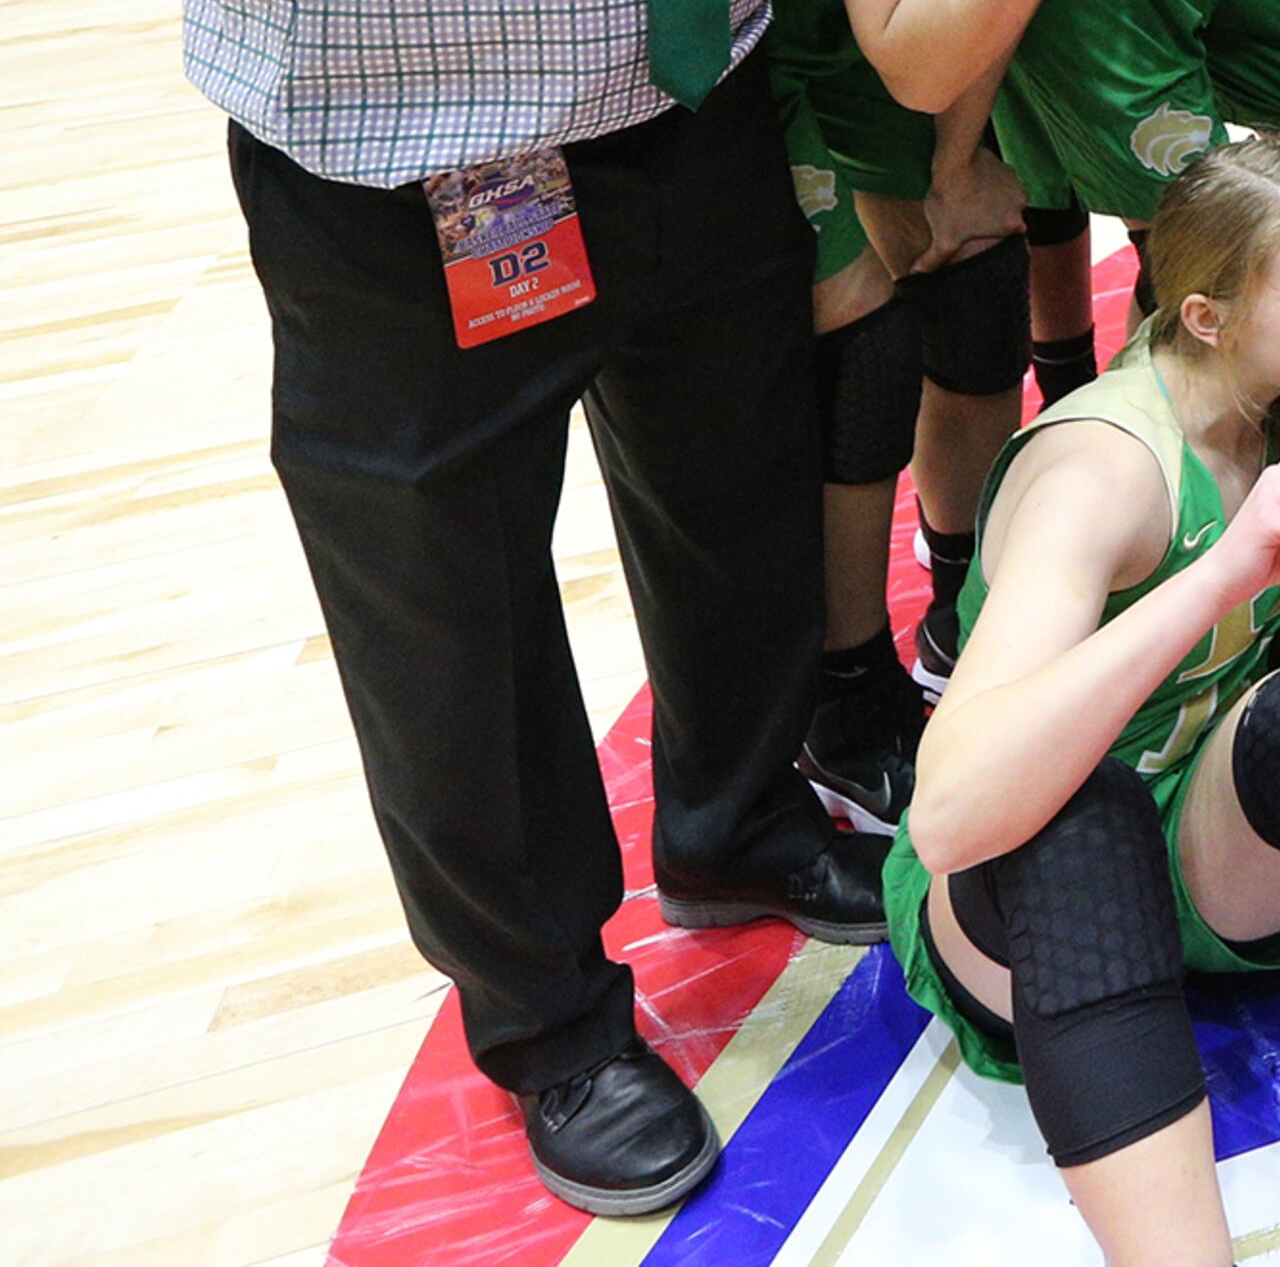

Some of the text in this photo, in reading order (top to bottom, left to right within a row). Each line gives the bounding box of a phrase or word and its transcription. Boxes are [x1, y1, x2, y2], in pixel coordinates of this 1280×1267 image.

[468, 174, 535, 210] GHSA
[488, 240, 550, 287] D2
[509, 282, 531, 299] DAY
